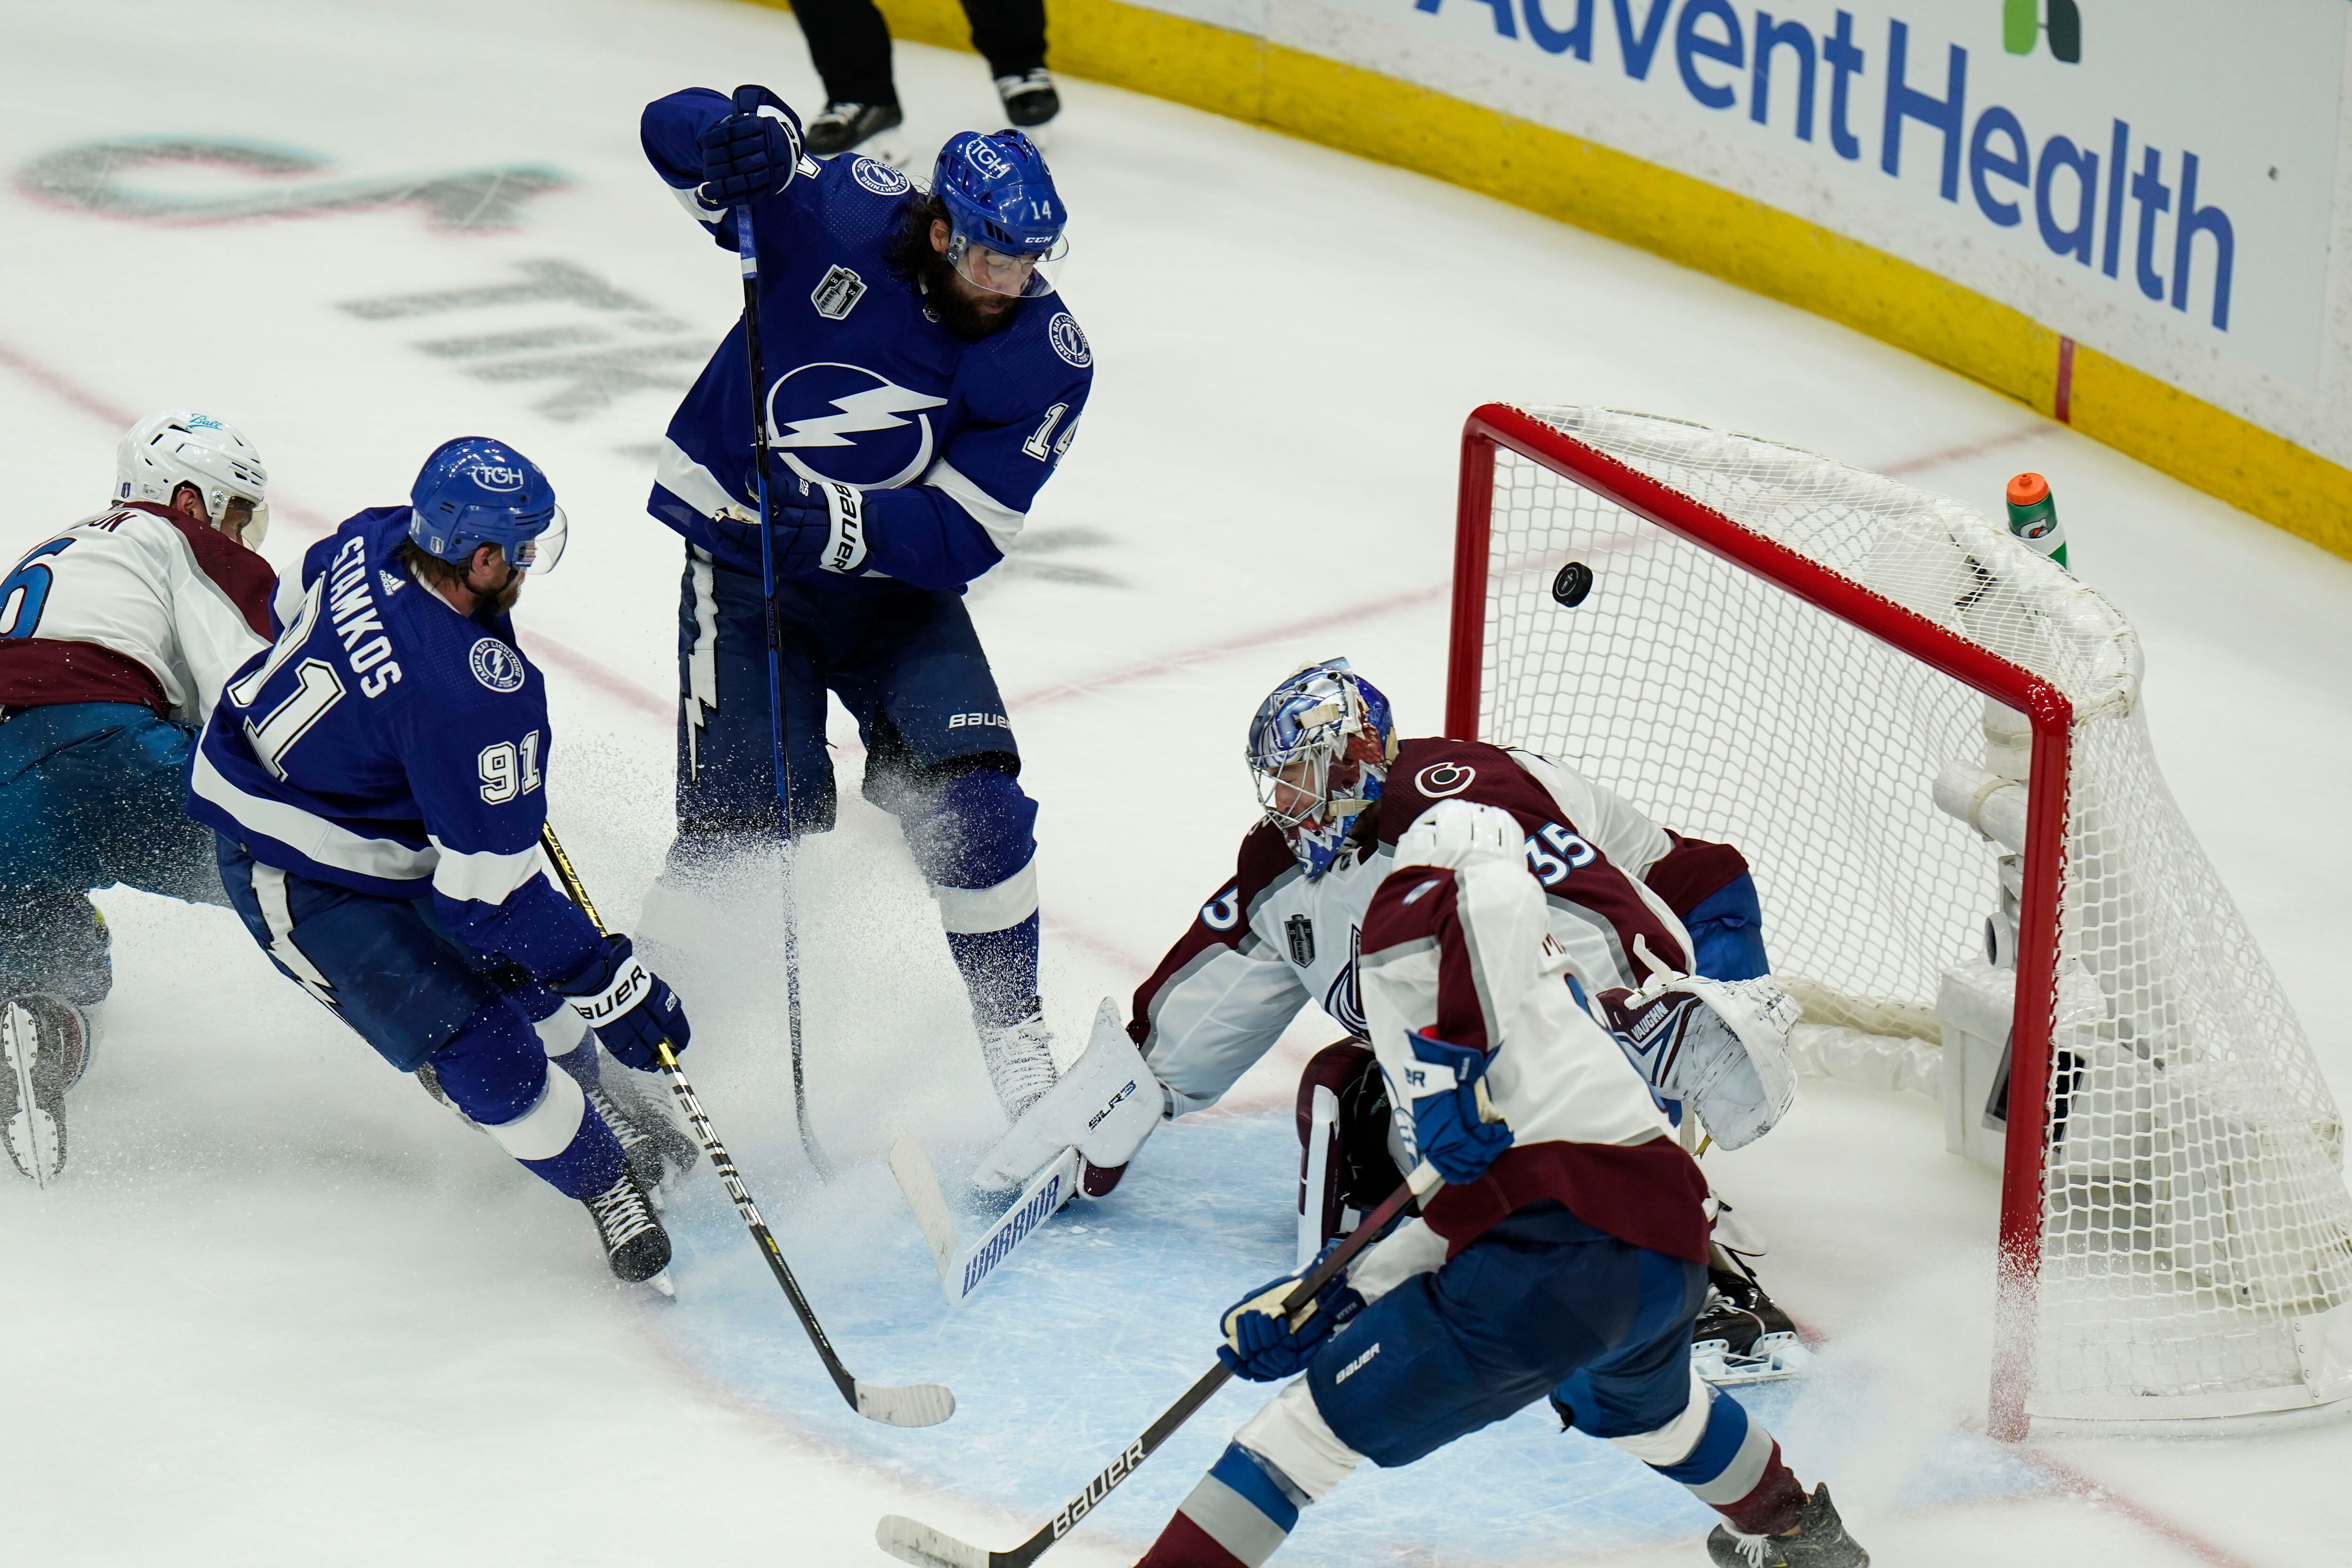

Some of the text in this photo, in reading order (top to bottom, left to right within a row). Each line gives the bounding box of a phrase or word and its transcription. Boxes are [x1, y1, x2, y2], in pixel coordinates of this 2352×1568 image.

[971, 140, 1010, 179] TGH
[860, 176, 904, 192] LIGHTNING
[1031, 200, 1052, 220] 14
[1053, 318, 1061, 333] BAY
[1053, 334, 1072, 360] TAMPA
[186, 414, 222, 430] Ball
[479, 467, 524, 485] TGH
[379, 570, 393, 596] adidas
[330, 535, 402, 699] STAMKOS
[474, 641, 521, 682] TAMPA BAY LIGHTNING
[477, 729, 541, 805] 91
[1524, 821, 1597, 888] 35
[570, 964, 647, 1020] AUER
[1630, 1000, 1669, 1041] VAUGHN
[961, 1175, 1059, 1299] WARRIOR
[1335, 1342, 1381, 1385] BAUER
[1053, 1438, 1146, 1539] BAUER
